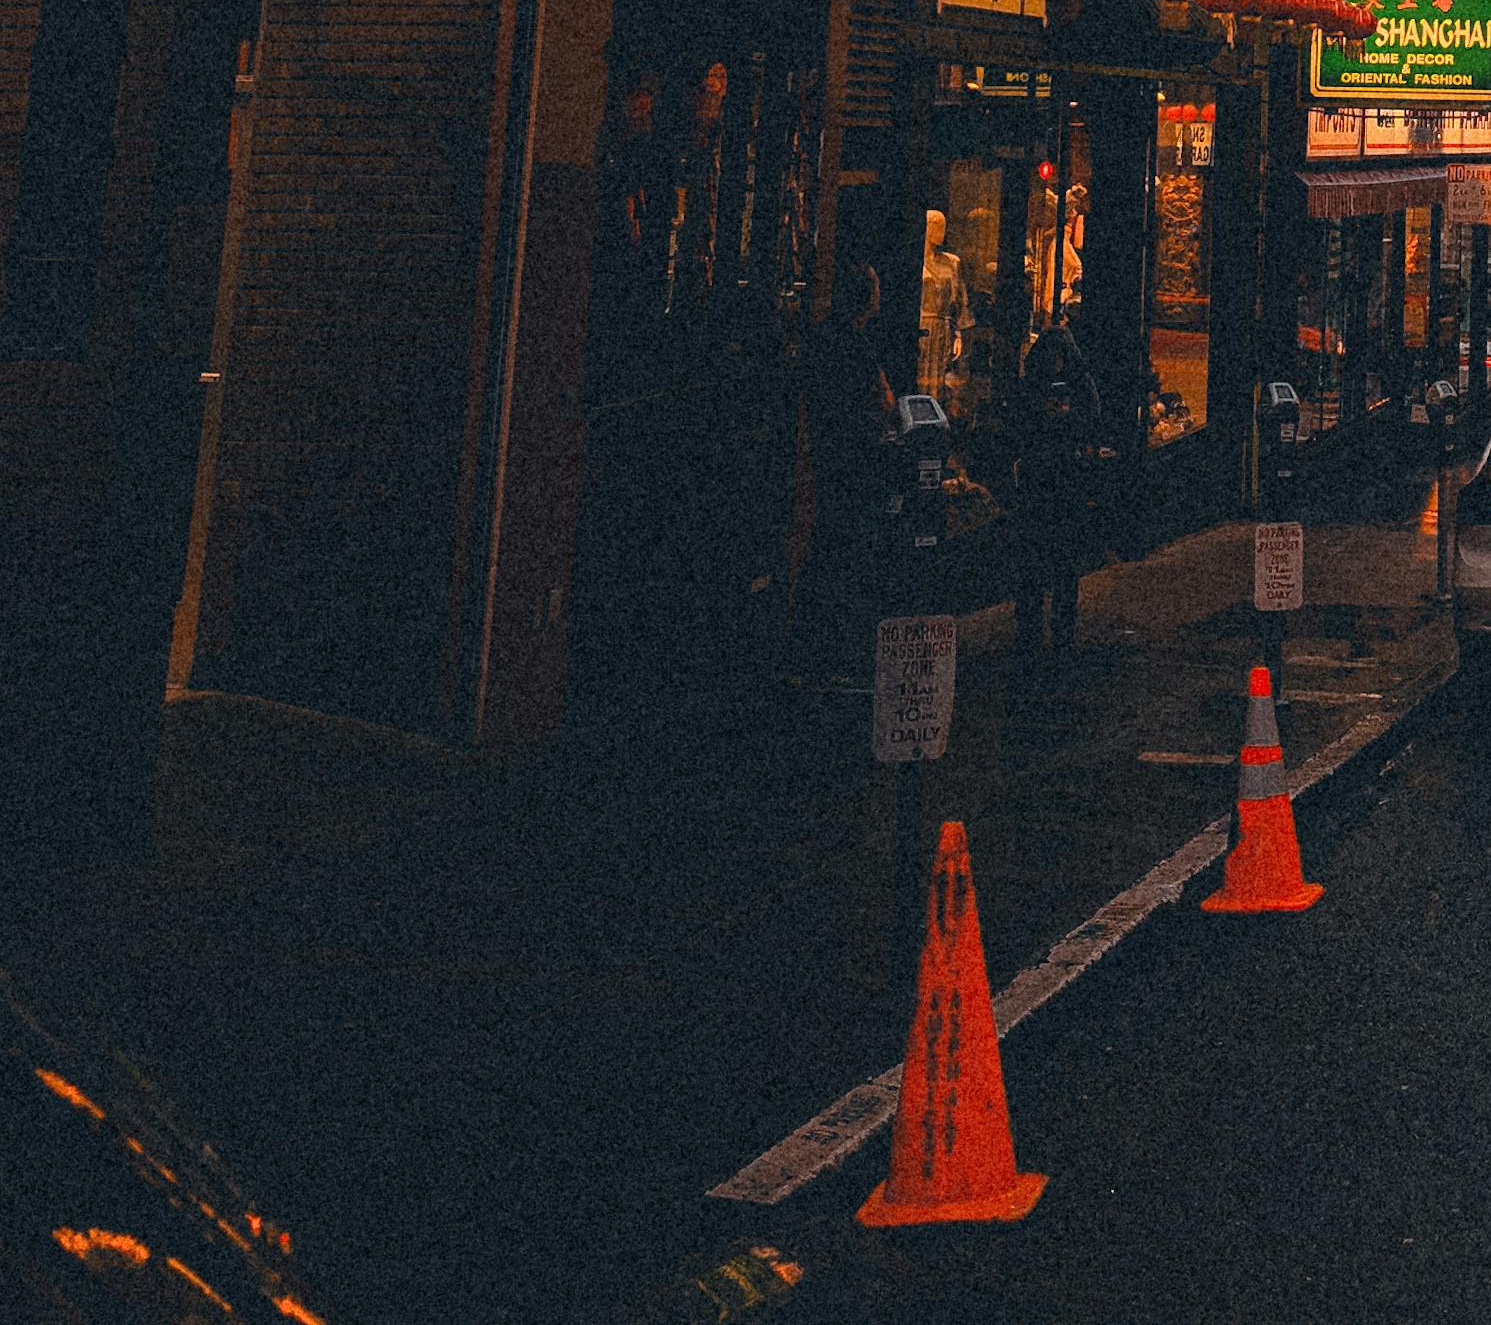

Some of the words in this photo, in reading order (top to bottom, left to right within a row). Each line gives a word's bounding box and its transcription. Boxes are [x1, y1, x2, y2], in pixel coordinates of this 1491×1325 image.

[1375, 17, 1491, 48] SHANGHAI
[1359, 53, 1399, 64] HOME
[1407, 53, 1454, 64] DECOR
[1341, 72, 1407, 84] ORIENTAL
[1414, 74, 1472, 86] FASHION
[881, 626, 899, 642] NO
[905, 623, 953, 642] PARKING
[902, 661, 935, 677] ZONE
[890, 727, 940, 743] DAILY
